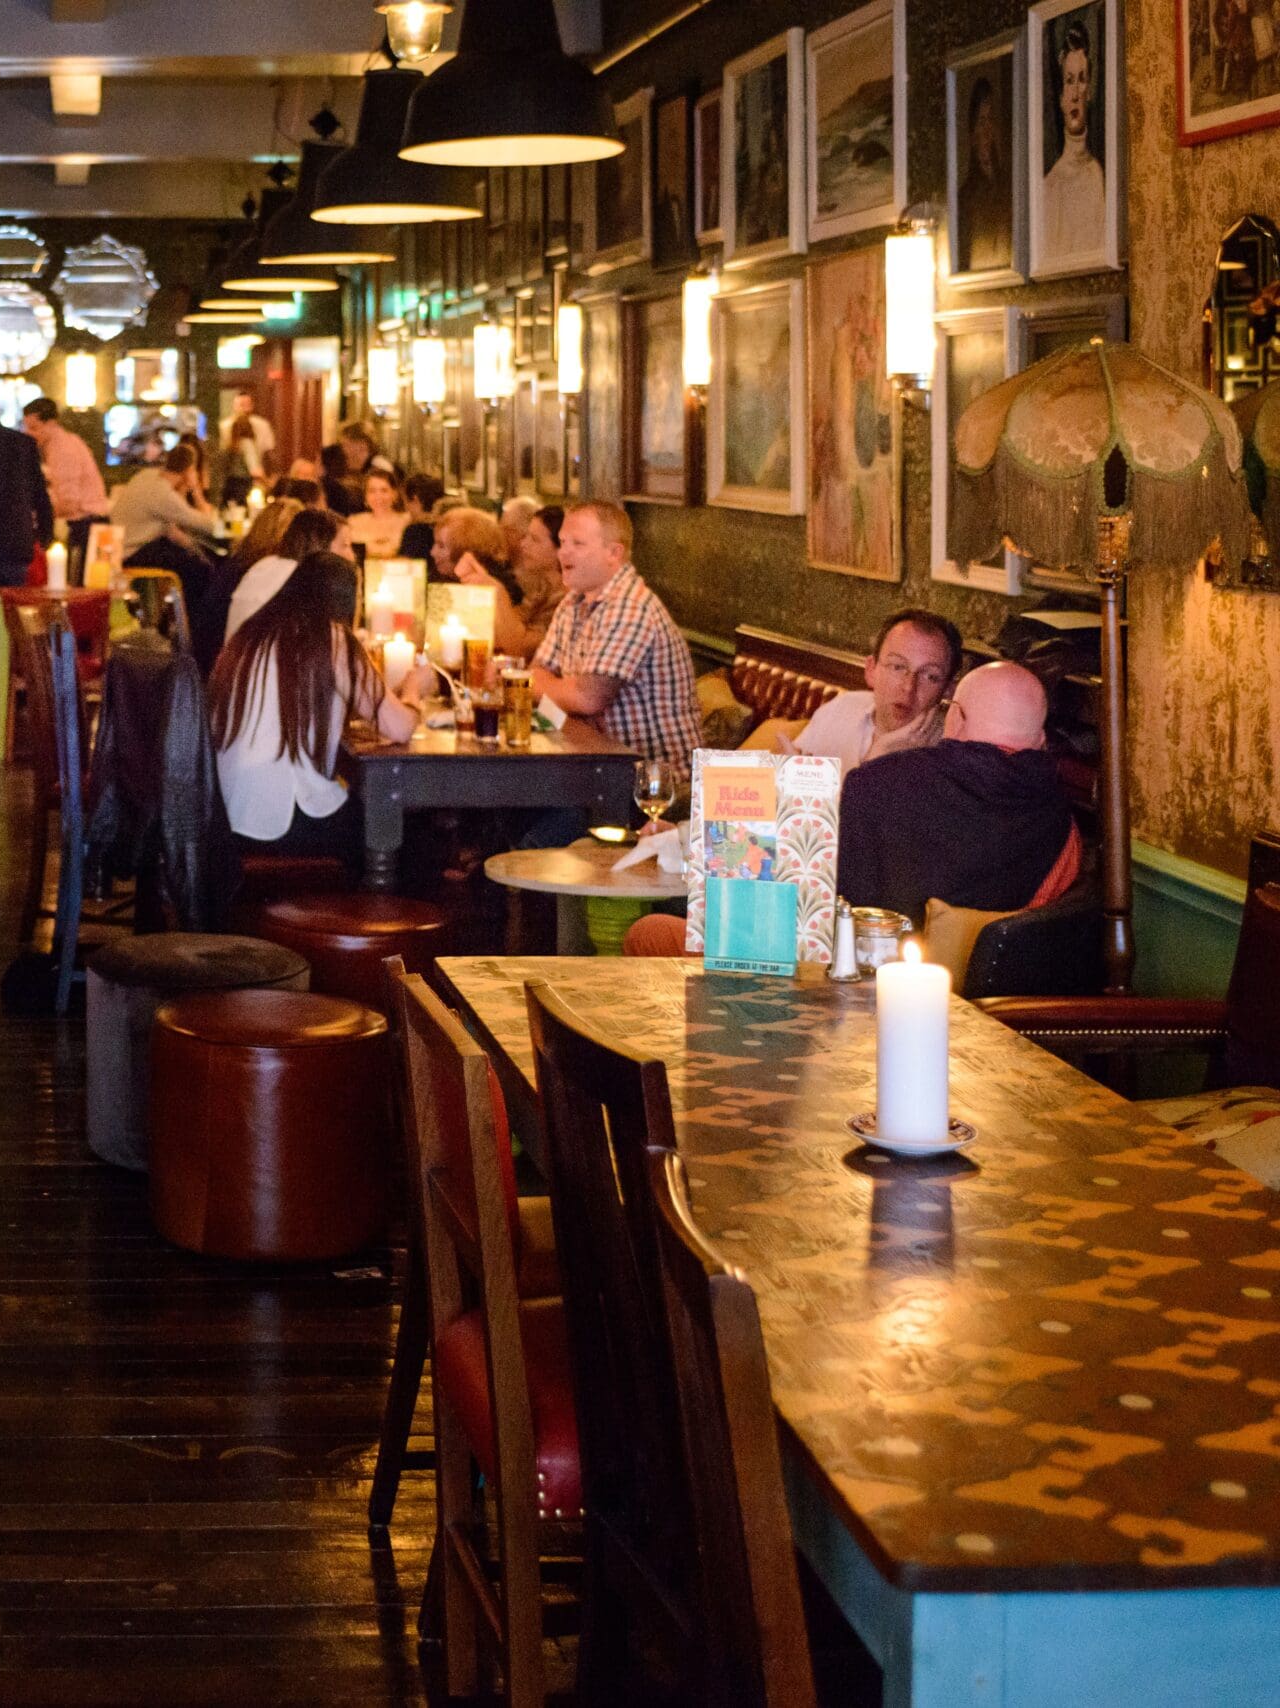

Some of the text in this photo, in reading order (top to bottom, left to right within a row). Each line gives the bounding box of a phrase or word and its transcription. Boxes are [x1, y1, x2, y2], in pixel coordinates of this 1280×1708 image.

[796, 769, 824, 780] MENU
[718, 785, 760, 801] Kids
[713, 801, 765, 817] Menu
[714, 960, 733, 969] PLEASE
[733, 961, 751, 970] ORDER
[759, 964, 769, 972] THE
